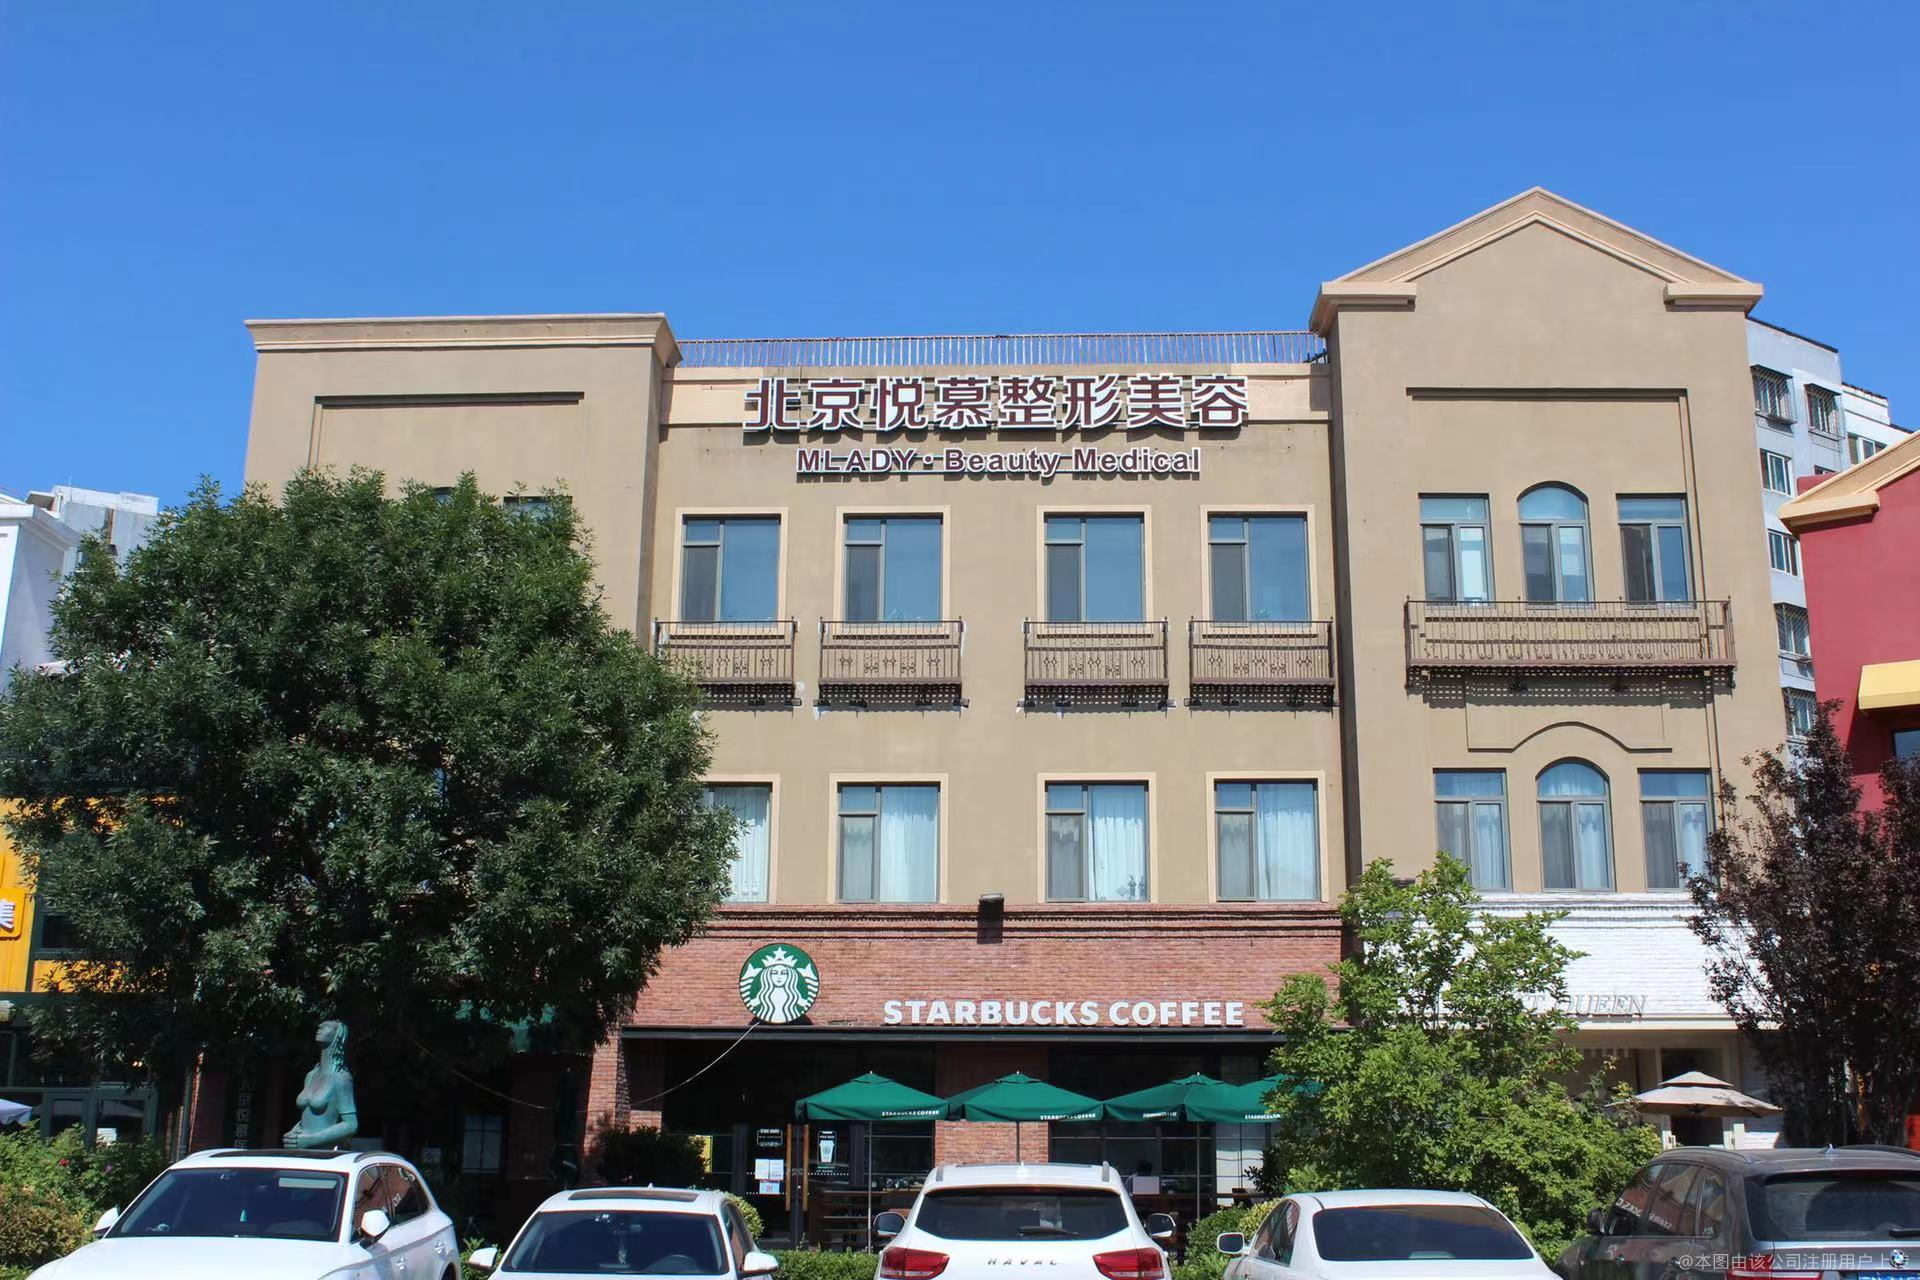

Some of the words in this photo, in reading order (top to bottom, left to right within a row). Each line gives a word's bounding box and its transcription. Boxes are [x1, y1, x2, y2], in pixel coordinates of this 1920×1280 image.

[743, 374, 1249, 431] 北京悦慕整形美容
[1073, 447, 1200, 474] Medical
[884, 1000, 1099, 1025] STARBUCKS
[1109, 1001, 1244, 1025] COFFEE
[987, 1257, 1060, 1266] HAVAL
